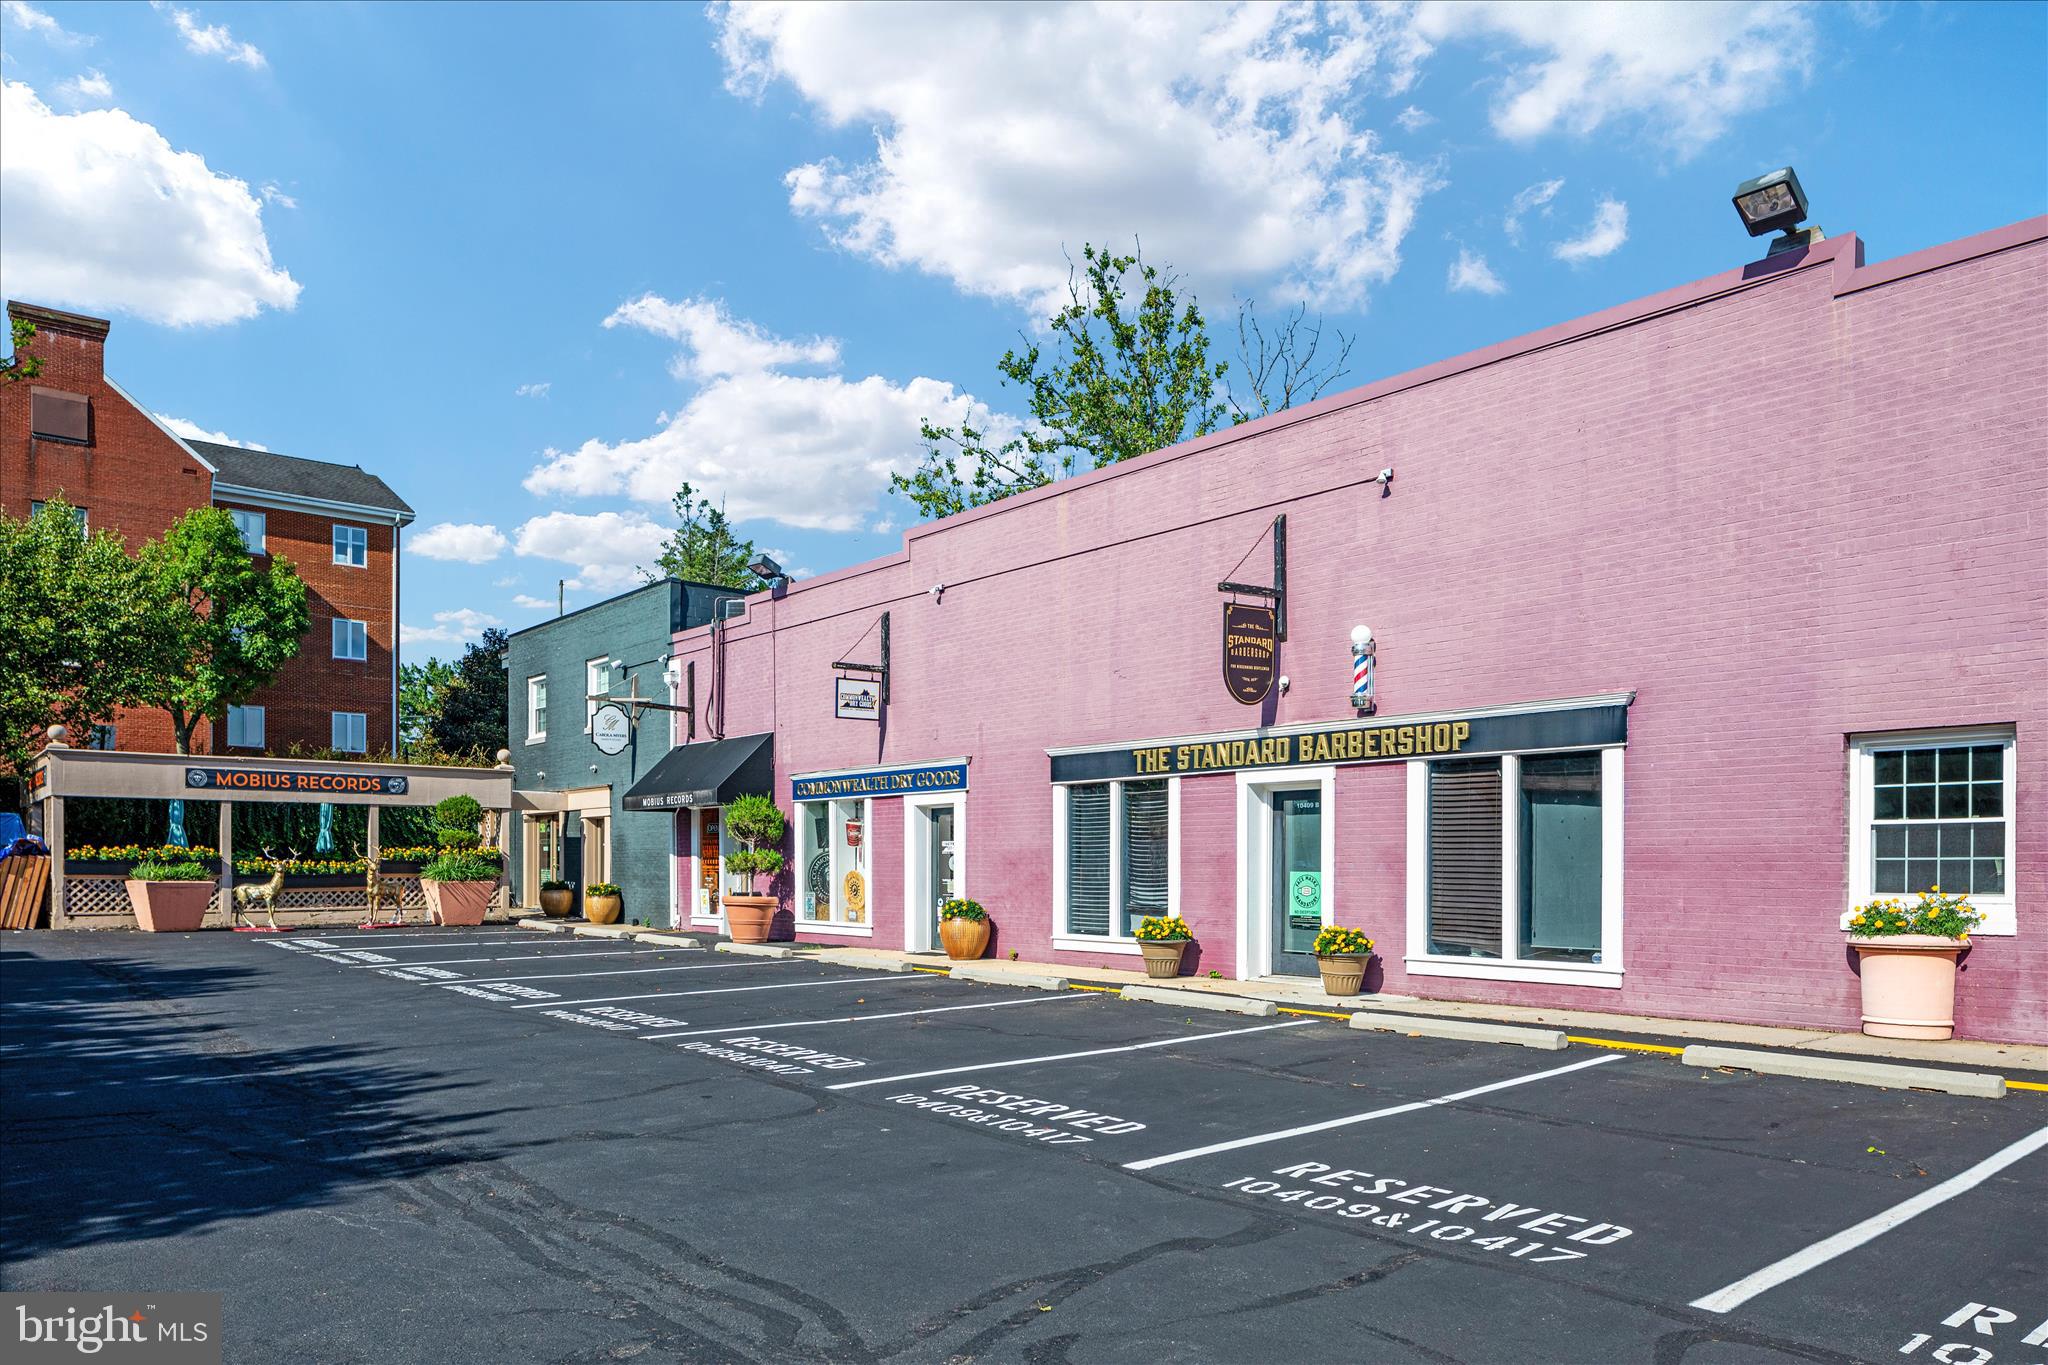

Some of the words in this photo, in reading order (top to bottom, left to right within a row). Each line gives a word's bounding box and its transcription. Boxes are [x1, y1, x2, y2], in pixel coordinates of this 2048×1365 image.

[1228, 634, 1273, 653] STANDARD
[1230, 647, 1270, 659] BARBERSHOP
[1133, 747, 1172, 774] THE
[1176, 736, 1291, 771] STANDARD
[1298, 721, 1471, 762] BARBERSHOP
[215, 771, 291, 788] MOBIUS
[297, 775, 381, 791] RECORDS
[796, 776, 889, 797] COMMONWEALTH
[891, 773, 915, 790] DRY
[916, 769, 960, 787] GOODS
[642, 796, 664, 807] MOBIUS
[666, 793, 693, 805] RECORDS
[1295, 877, 1304, 887] FACE
[1305, 876, 1319, 887] MASKS
[1295, 895, 1318, 907] MANDATORY
[677, 1041, 815, 1077] 10409&10417
[720, 1036, 867, 1071] RESERVED
[885, 1092, 1094, 1145] 10409&10417
[932, 1084, 1147, 1136] RESERVED
[1272, 1161, 1633, 1245] RESERVED
[1222, 1176, 1588, 1263] 10409&10417
